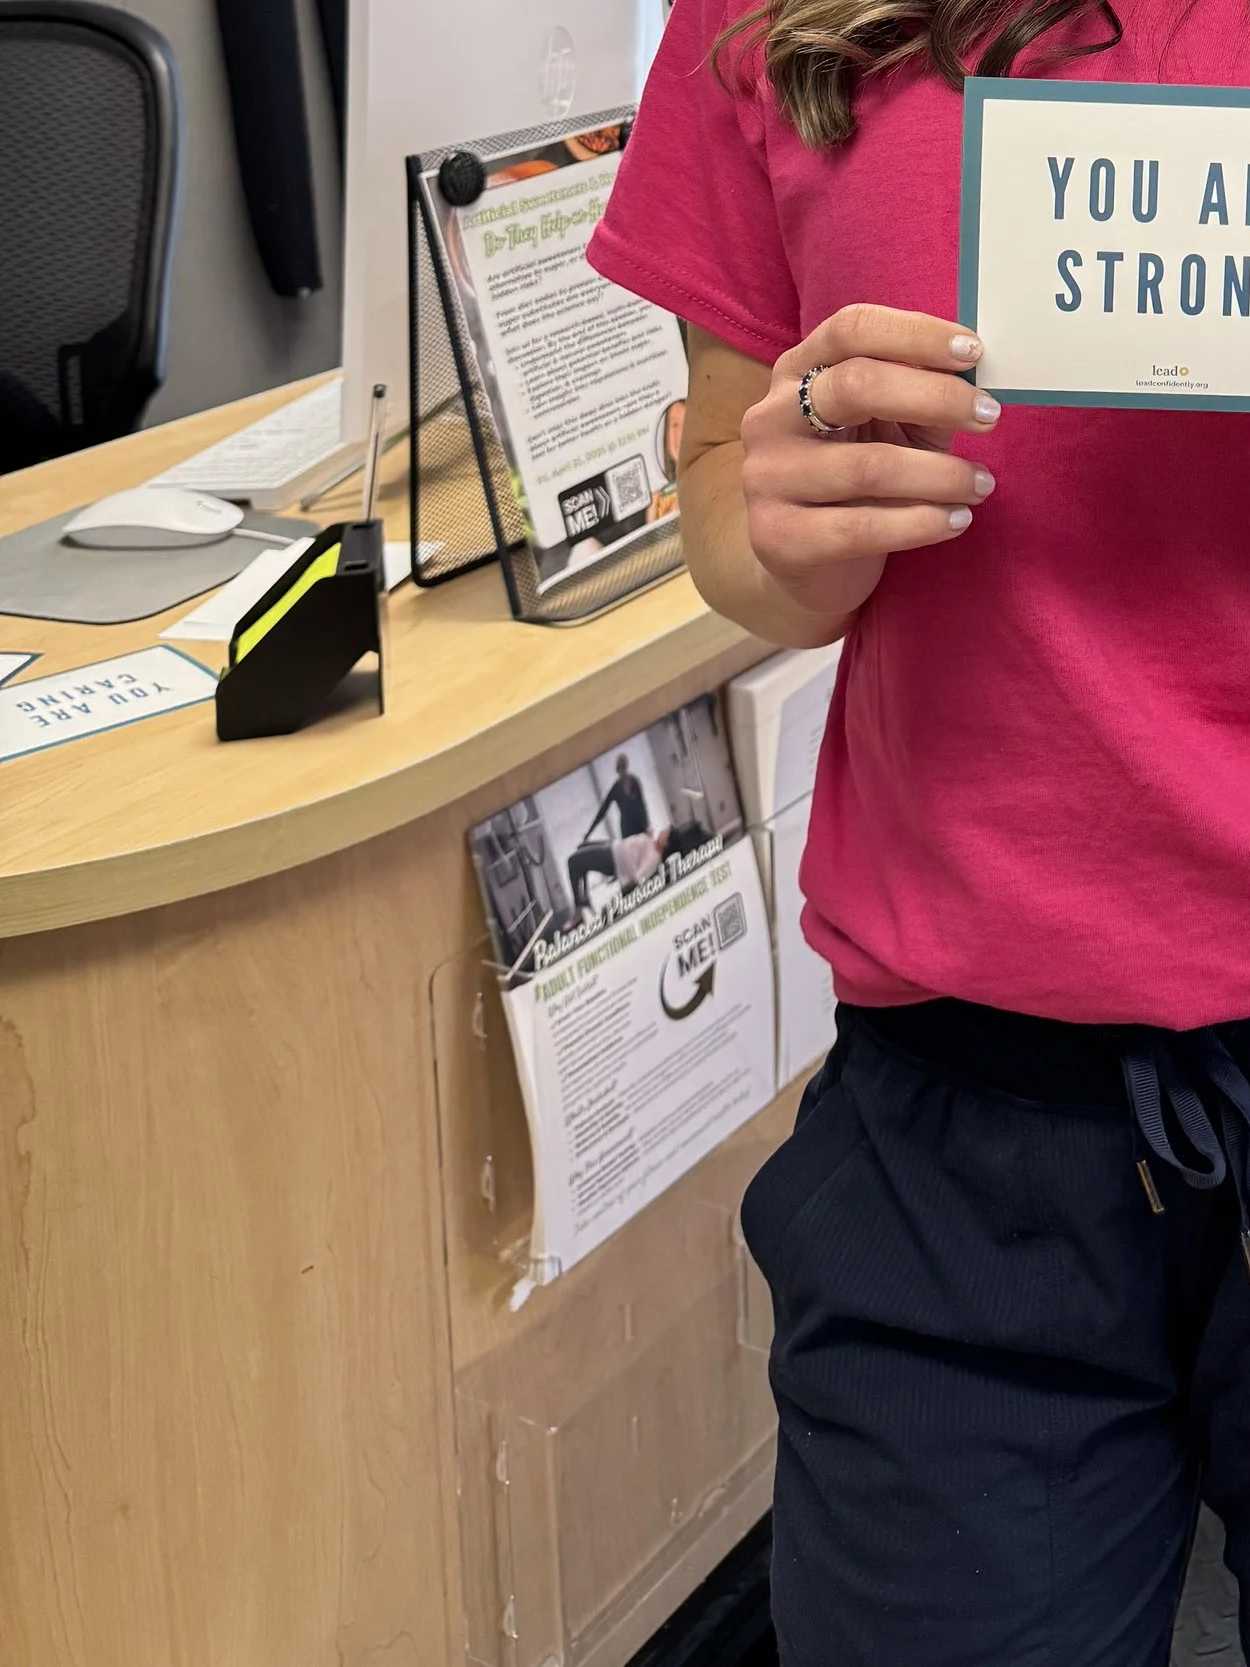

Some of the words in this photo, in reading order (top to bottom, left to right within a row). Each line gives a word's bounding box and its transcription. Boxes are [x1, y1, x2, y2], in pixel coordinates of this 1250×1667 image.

[1048, 157, 1159, 223] YOU
[484, 230, 507, 257] Do
[506, 222, 538, 250] They
[540, 209, 569, 240] Help
[1136, 380, 1209, 389] leadconfidently.org
[1152, 365, 1178, 376] lead
[561, 488, 594, 514] SCAN
[565, 503, 599, 537] ME!
[16, 673, 137, 712] CARING
[108, 682, 171, 705] YOU
[30, 702, 91, 728] ARE
[605, 864, 666, 925] Physical
[665, 834, 724, 883] Therapy
[673, 914, 711, 949] SCAN
[677, 933, 717, 977] ME!
